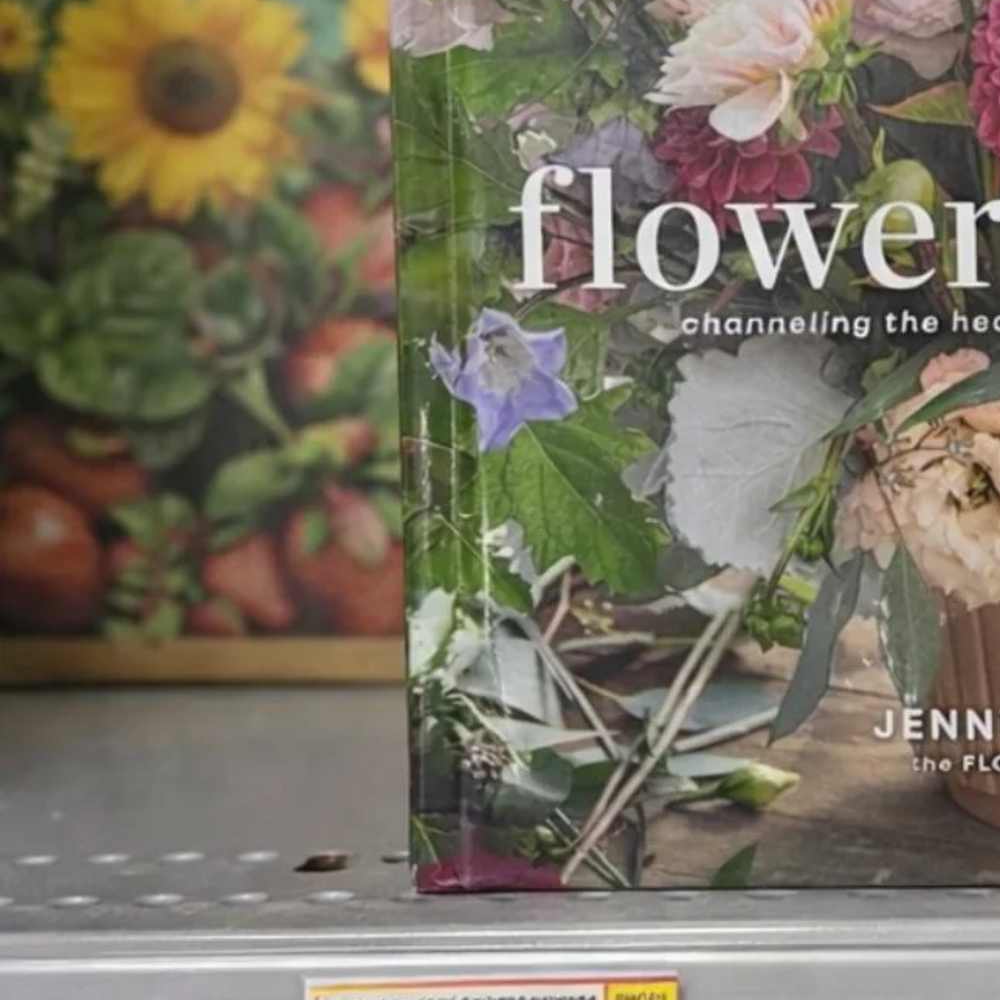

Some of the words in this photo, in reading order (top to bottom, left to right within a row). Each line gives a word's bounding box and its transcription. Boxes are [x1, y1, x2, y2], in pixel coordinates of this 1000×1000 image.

[681, 311, 871, 337] channeling
[885, 310, 939, 333] the
[912, 756, 951, 773] the
